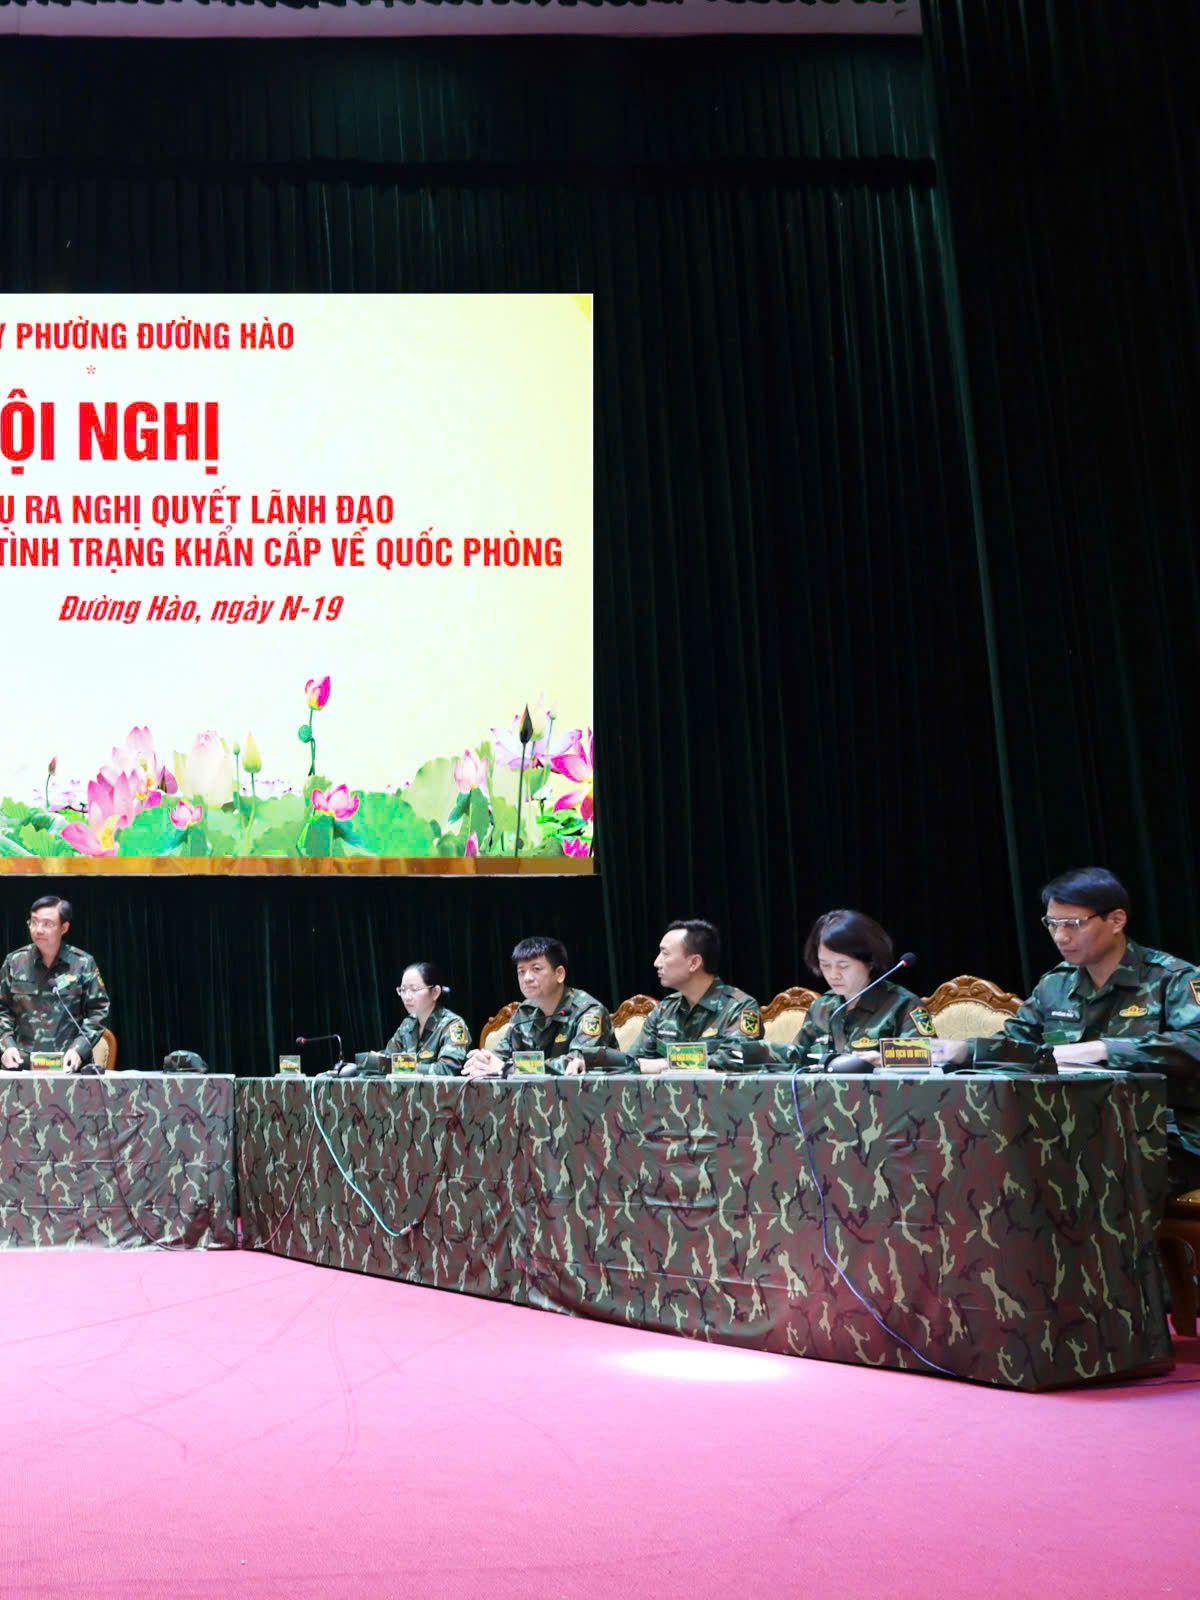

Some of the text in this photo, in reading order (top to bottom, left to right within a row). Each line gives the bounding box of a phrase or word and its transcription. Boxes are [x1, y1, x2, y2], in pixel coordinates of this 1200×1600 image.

[17, 316, 126, 349] PHƯỜNG
[137, 316, 229, 350] ĐƯỜNG
[241, 317, 293, 349] HÀO
[79, 402, 219, 475] NGHỊ
[26, 495, 62, 525] RA
[73, 495, 140, 531] NGHỊ
[152, 486, 240, 528] QUYẾT
[252, 489, 326, 525] LÃNH
[336, 495, 393, 530] ĐẠO
[69, 538, 164, 573] TRẠNG
[176, 525, 253, 567] KHẨN
[265, 527, 321, 567] CẤP
[377, 528, 452, 570] QUỐC
[464, 530, 562, 567] PHÒNG
[59, 595, 344, 624] Đường Hào, ngày N-19
